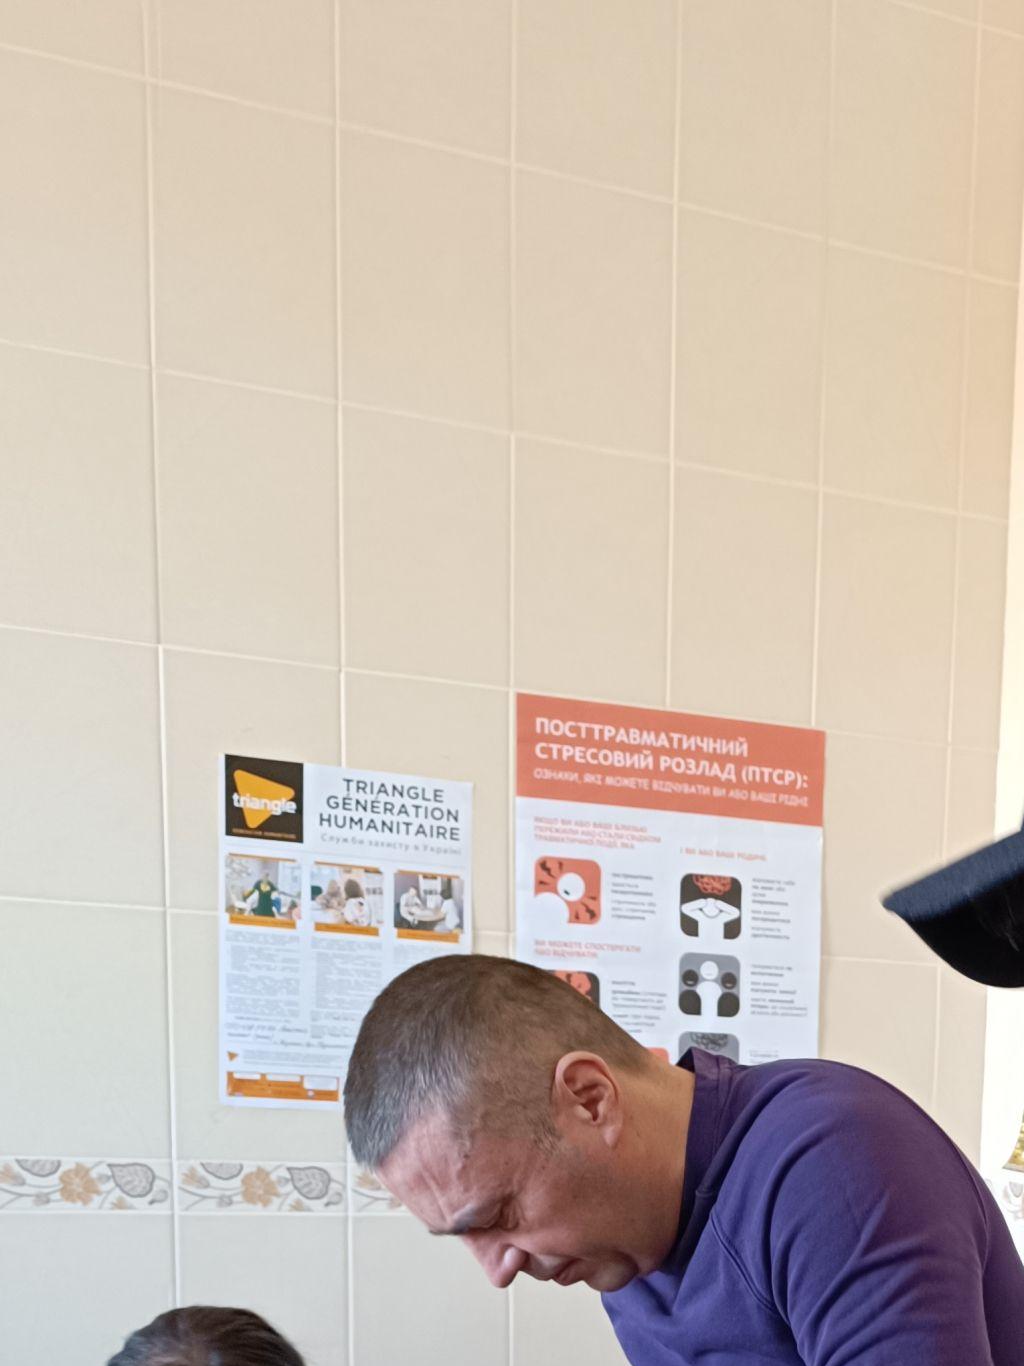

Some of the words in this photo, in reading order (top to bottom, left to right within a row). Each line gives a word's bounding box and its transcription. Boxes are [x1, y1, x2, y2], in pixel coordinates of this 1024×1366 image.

[535, 717, 749, 757] ПОСТТРАВМАТИЧНИЙ
[535, 742, 654, 770] СТРЕСОВИЙ
[659, 756, 737, 783] РОЗЛАД
[741, 764, 808, 790] (ПТСР):
[232, 792, 297, 815] triangle
[342, 778, 444, 803] TRIANGLE
[326, 793, 459, 823] GÉNÉRATION
[319, 813, 461, 841] HUMANITAIRE
